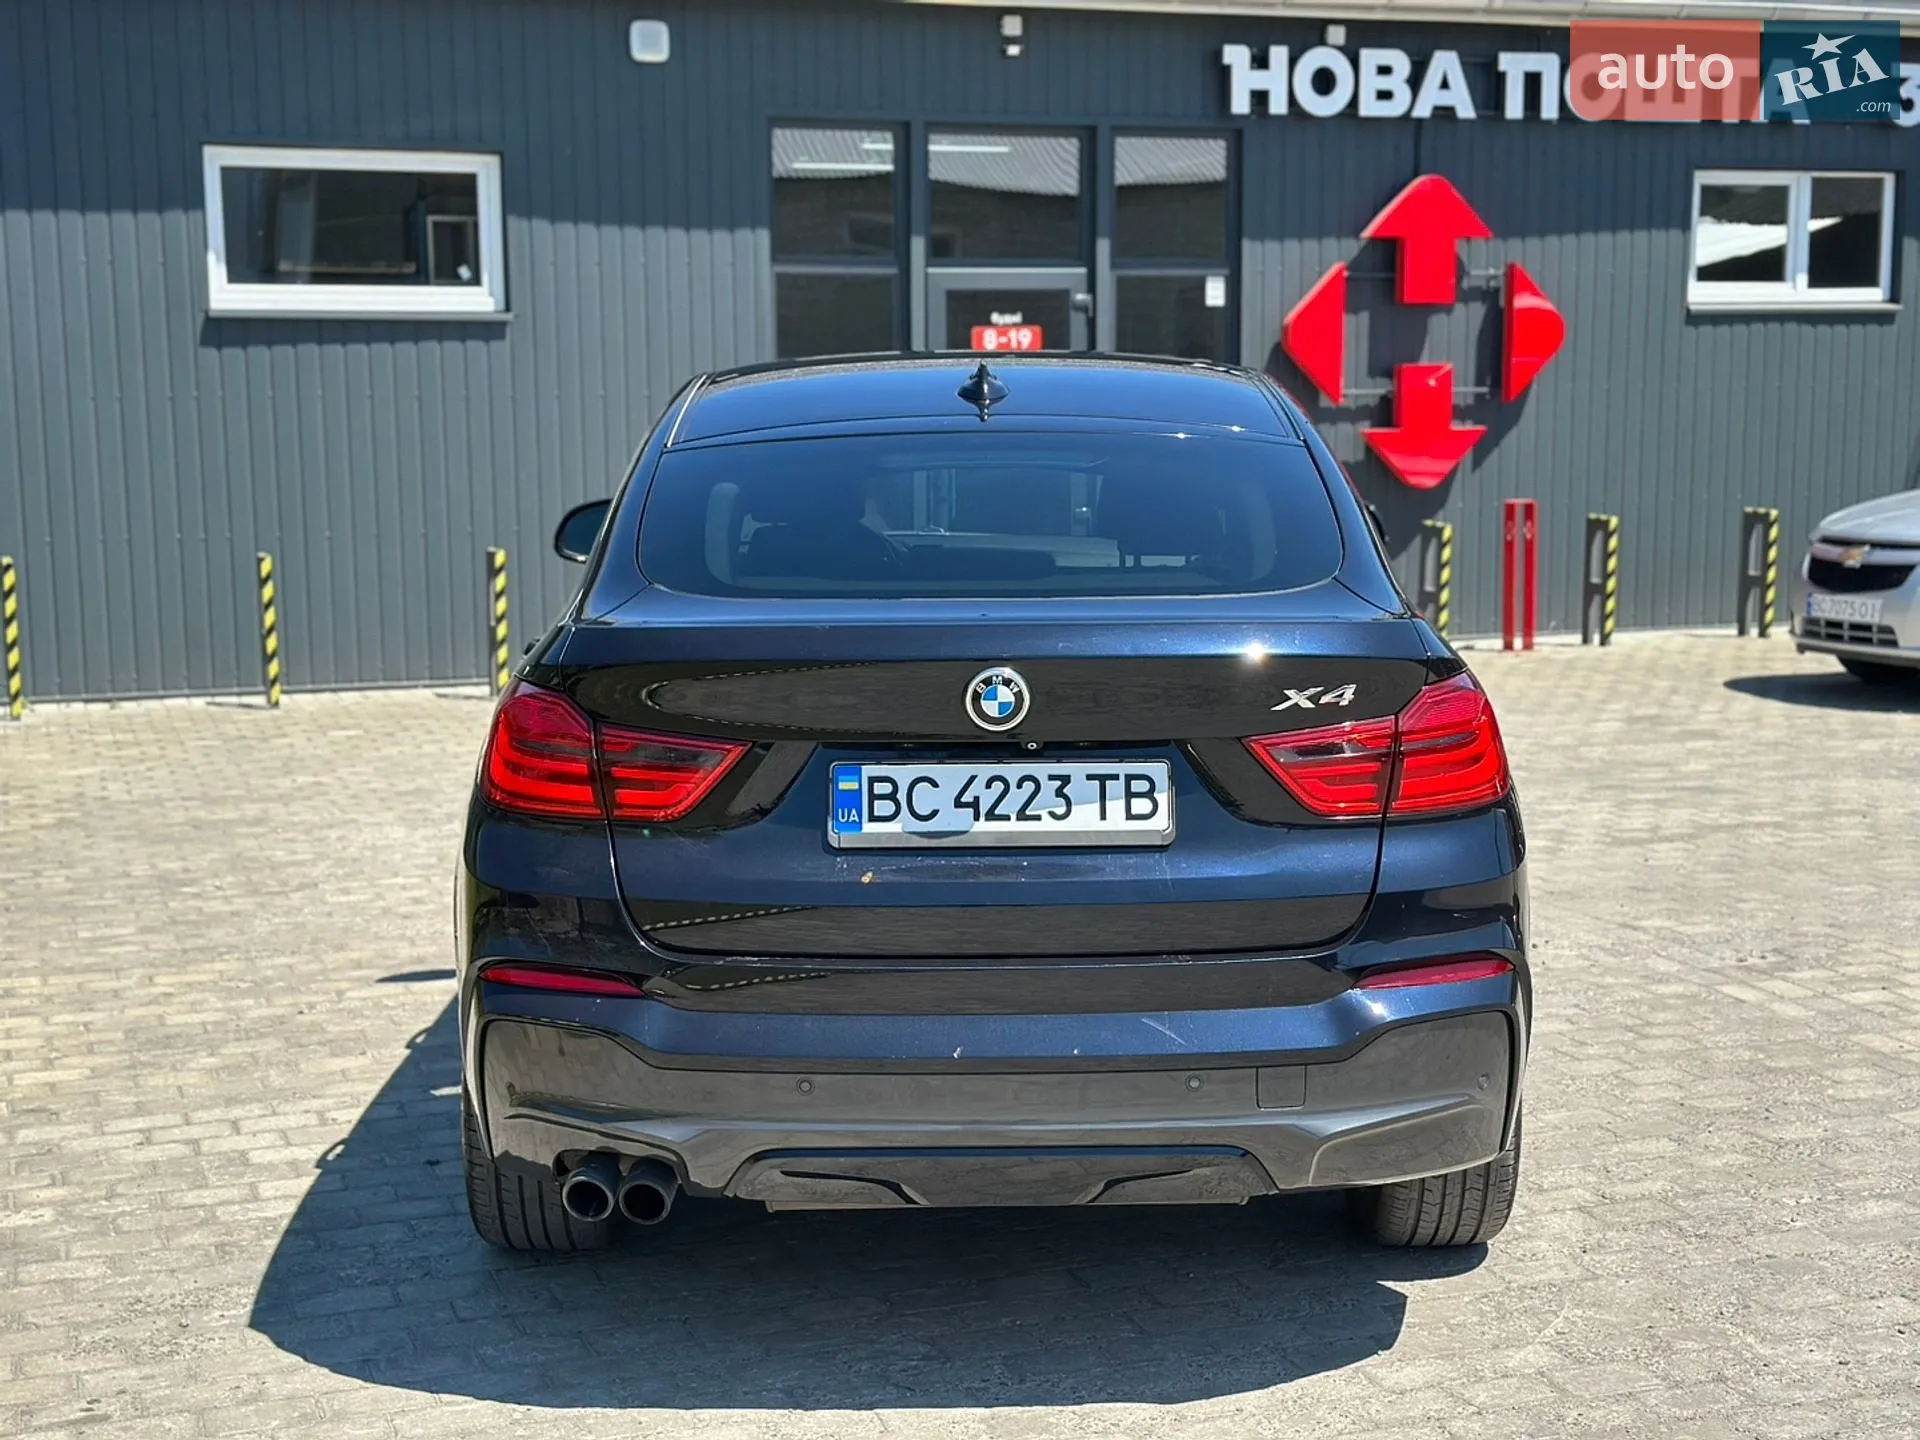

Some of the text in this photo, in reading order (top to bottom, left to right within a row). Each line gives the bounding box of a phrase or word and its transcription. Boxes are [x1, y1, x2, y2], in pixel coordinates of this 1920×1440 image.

[1222, 44, 1477, 120] НОВА
[982, 327, 1033, 350] 8-19
[976, 675, 1020, 693] BMW
[1270, 684, 1357, 711] X4
[867, 773, 1159, 823] BC 4223 TB
[838, 807, 859, 823] UA
